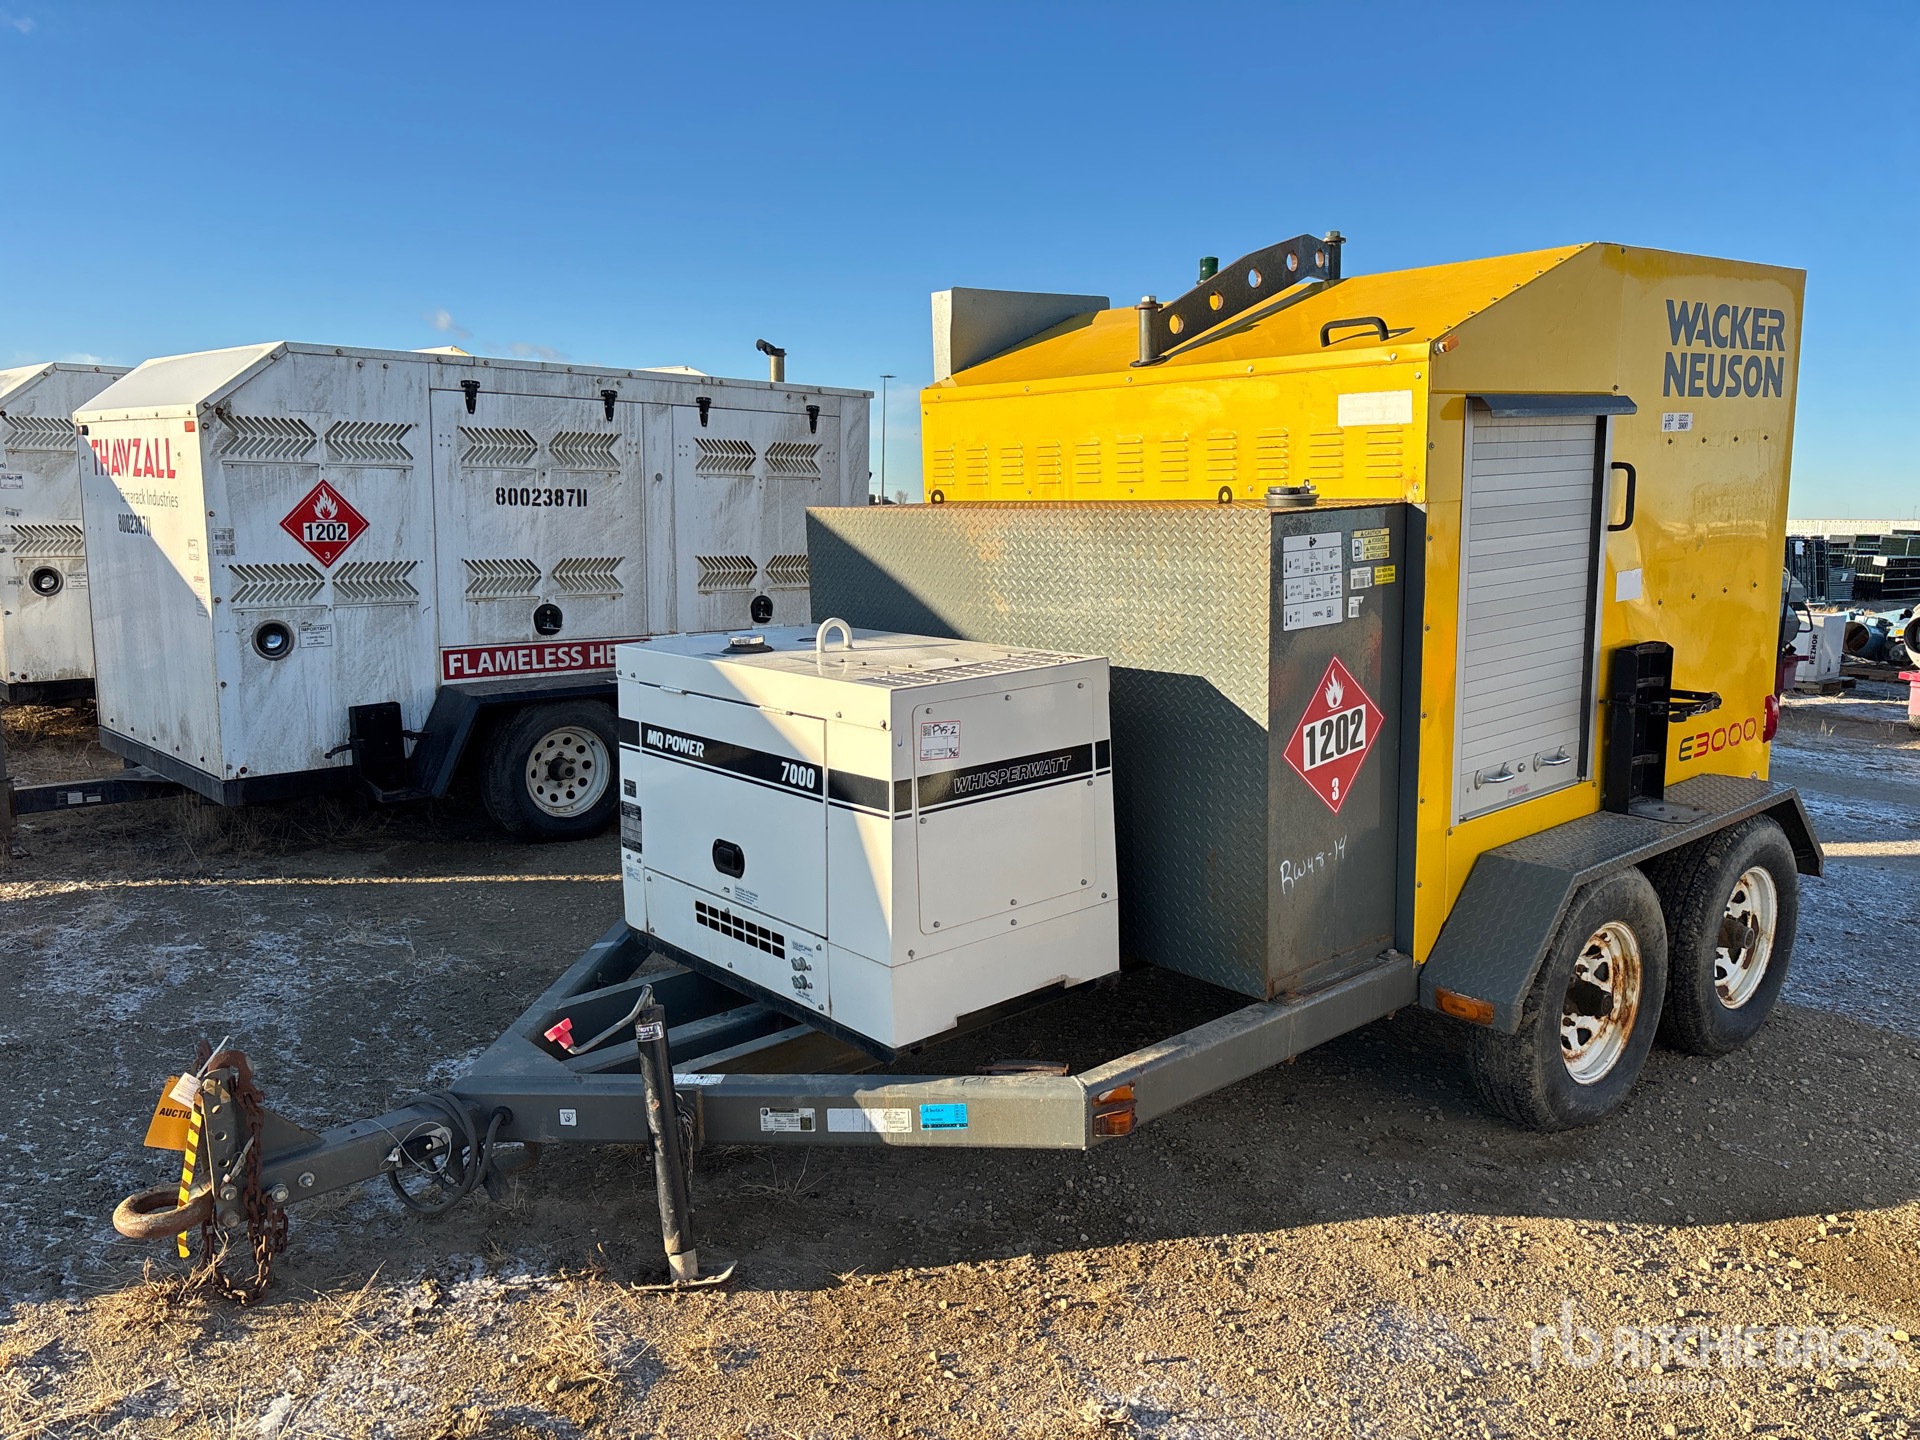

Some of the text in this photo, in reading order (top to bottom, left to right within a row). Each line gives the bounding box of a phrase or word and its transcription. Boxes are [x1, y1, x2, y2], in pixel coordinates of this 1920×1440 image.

[1666, 299, 1786, 352] WACKER
[1663, 352, 1785, 399] NEUSON
[91, 437, 177, 479] THAWZALL
[146, 488, 179, 508] Industries
[496, 486, 587, 507] 800238711
[304, 523, 347, 541] 1202
[324, 551, 331, 559] 3
[448, 646, 584, 676] FLAMELESS
[1809, 633, 1819, 665] REZNOR
[647, 730, 705, 758] MQ POWER
[1305, 708, 1364, 767] 1202
[1679, 717, 1757, 762] E3000
[780, 761, 816, 789] 7000
[953, 755, 1072, 794] WHISPERWATT
[1331, 777, 1340, 801] 3
